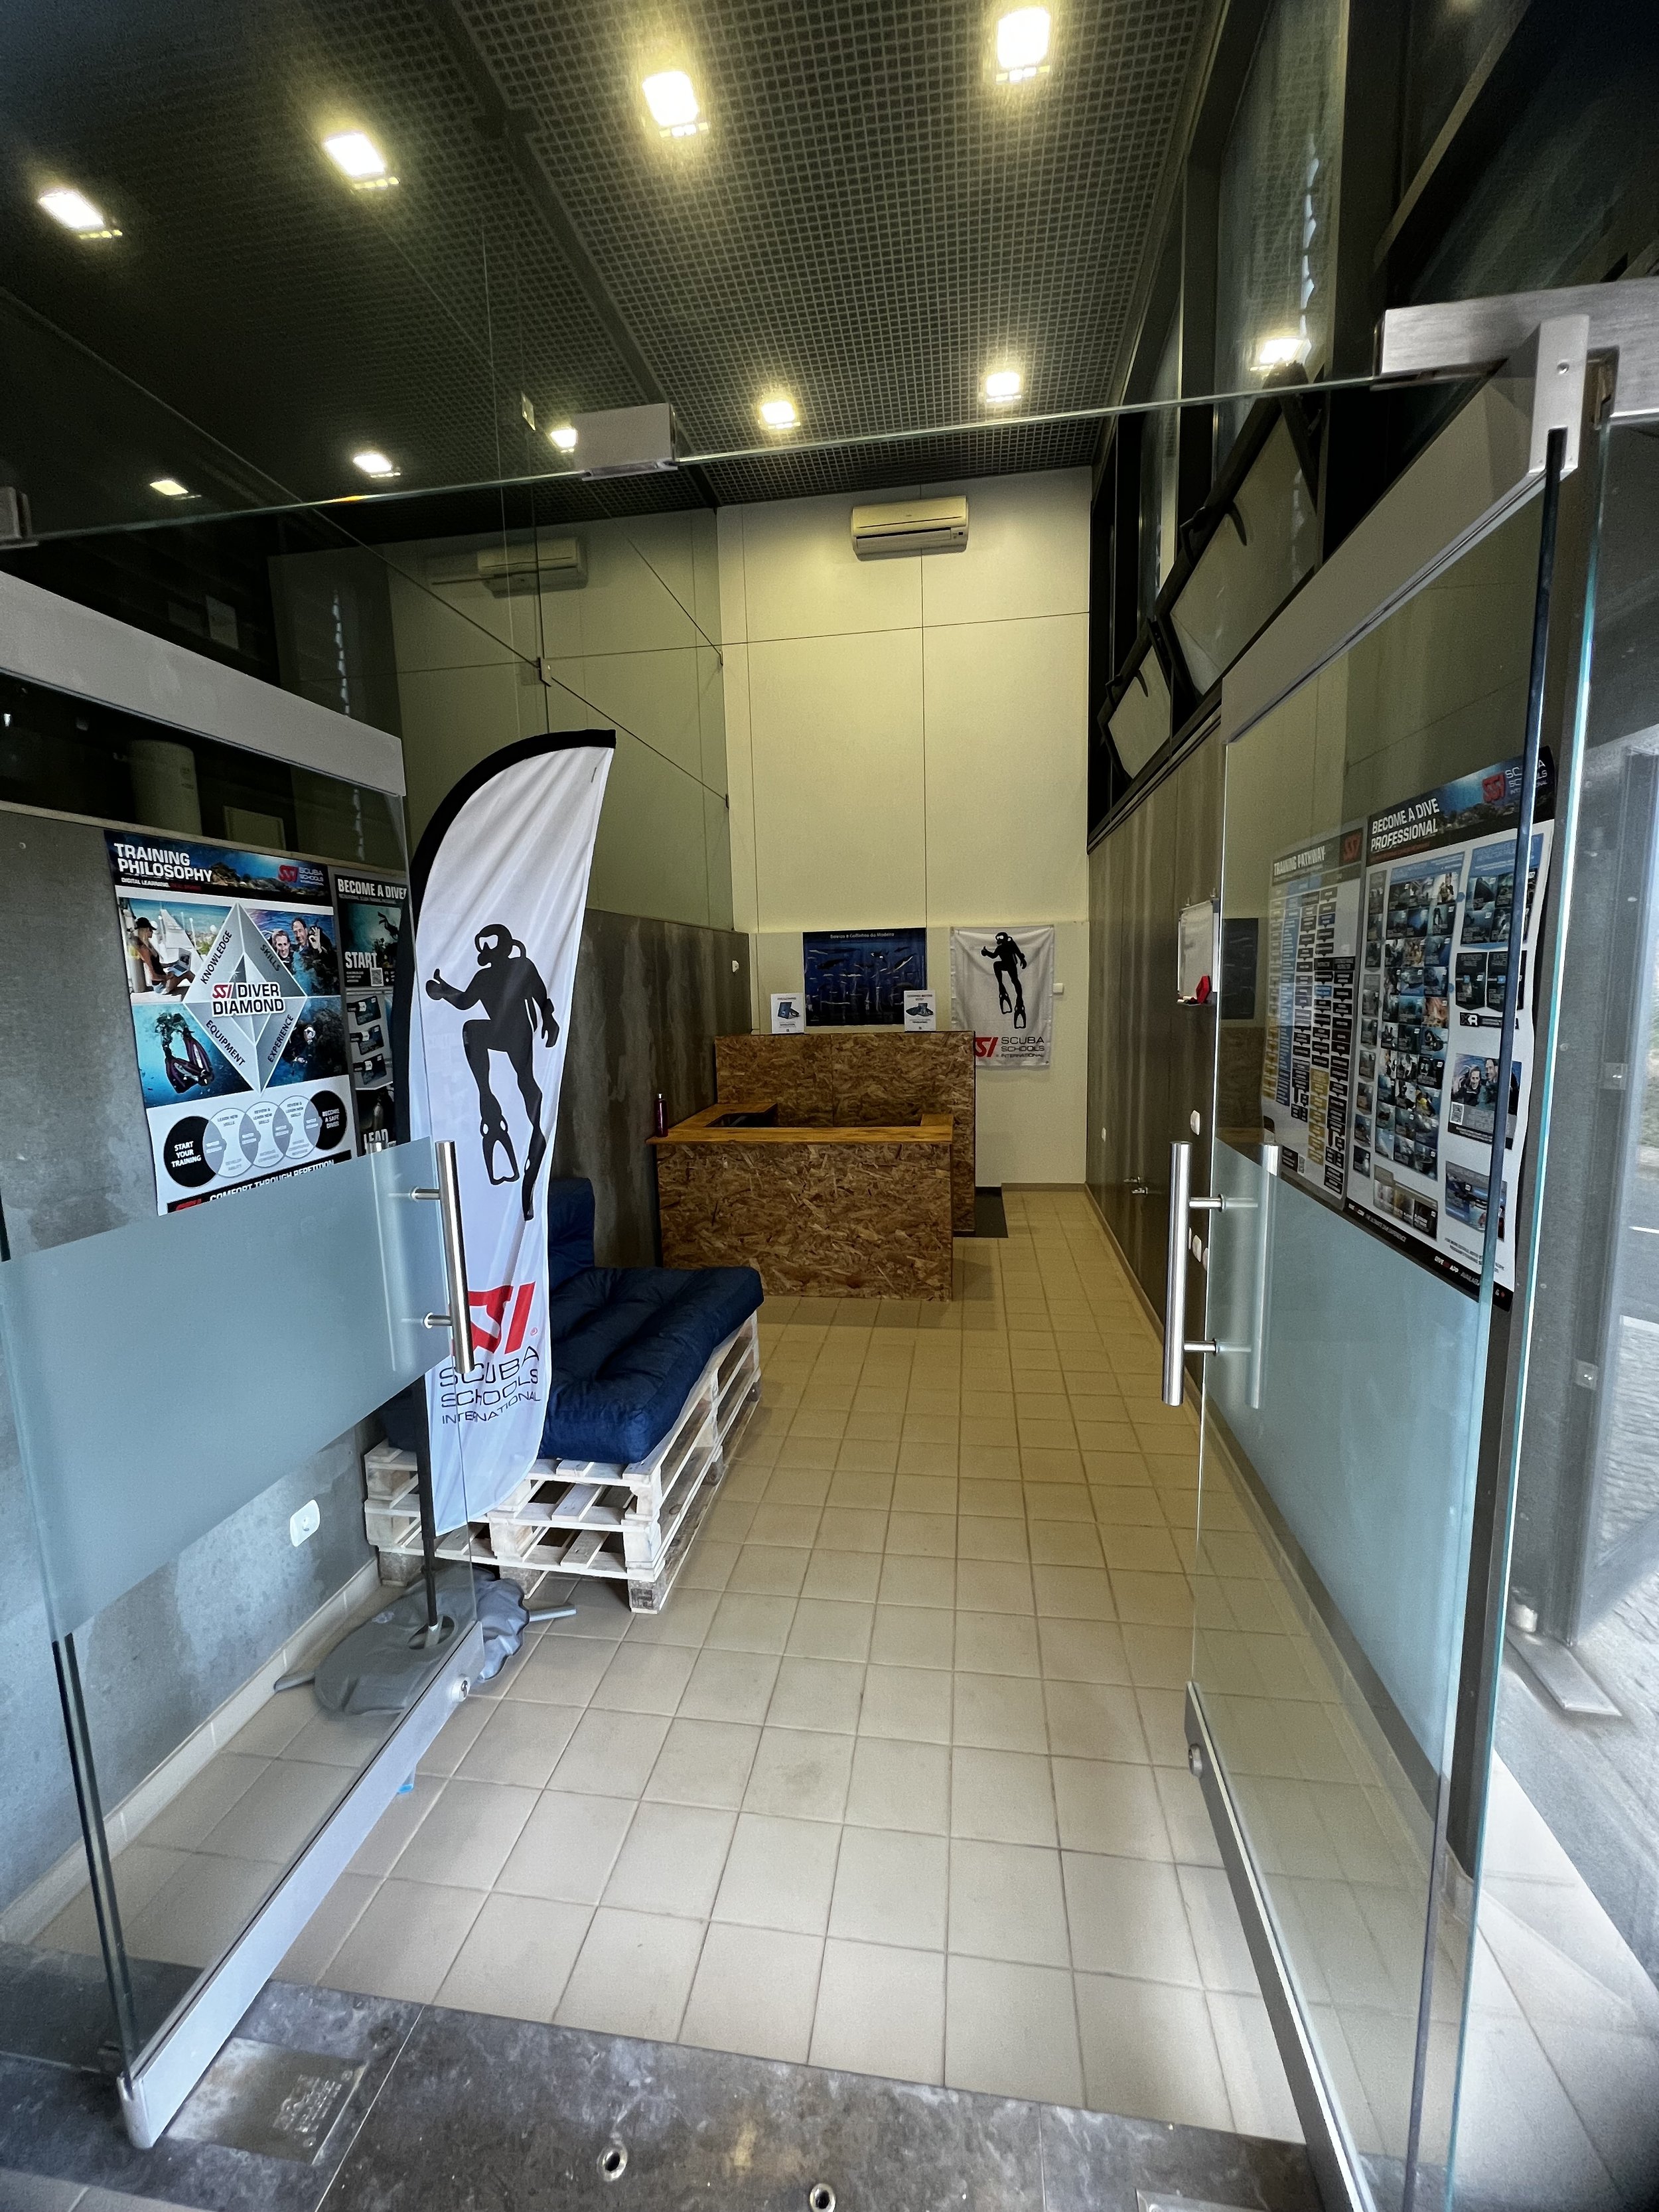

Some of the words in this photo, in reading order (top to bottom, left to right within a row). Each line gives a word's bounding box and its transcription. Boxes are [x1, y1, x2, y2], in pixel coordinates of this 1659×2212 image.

[1505, 759, 1546, 778] SCA
[1372, 810, 1407, 834] BECOME
[1408, 808, 1415, 822] A
[1415, 798, 1440, 819] DIVE
[1371, 818, 1438, 851] PROFESSIONAL
[113, 843, 190, 866] TRAINING
[117, 858, 212, 882] PHILOSOPHY
[279, 865, 299, 883] SSI
[299, 867, 323, 876] SCUBA
[338, 879, 376, 897] BECOME
[378, 885, 384, 897] A
[200, 930, 232, 984] KNOWLEDGE
[260, 944, 281, 972] SKILLS
[344, 952, 377, 968] START
[212, 984, 234, 999] SSI
[238, 984, 279, 997] DIVER
[213, 999, 284, 1015] DIAMOND
[206, 1020, 246, 1066] EQUIPMENT
[268, 1014, 293, 1063] EXPERIENCE
[975, 1037, 999, 1058] SI
[1001, 1036, 1045, 1045] SCUBA
[175, 1141, 194, 1151] START
[176, 1149, 194, 1159] YOUR
[171, 1155, 201, 1167] TRAINING
[453, 1281, 536, 1355] SI
[439, 1345, 540, 1387] SCUBA
[441, 1368, 538, 1408] SCHOOLS
[442, 1391, 541, 1424] INTERNATIONAL
